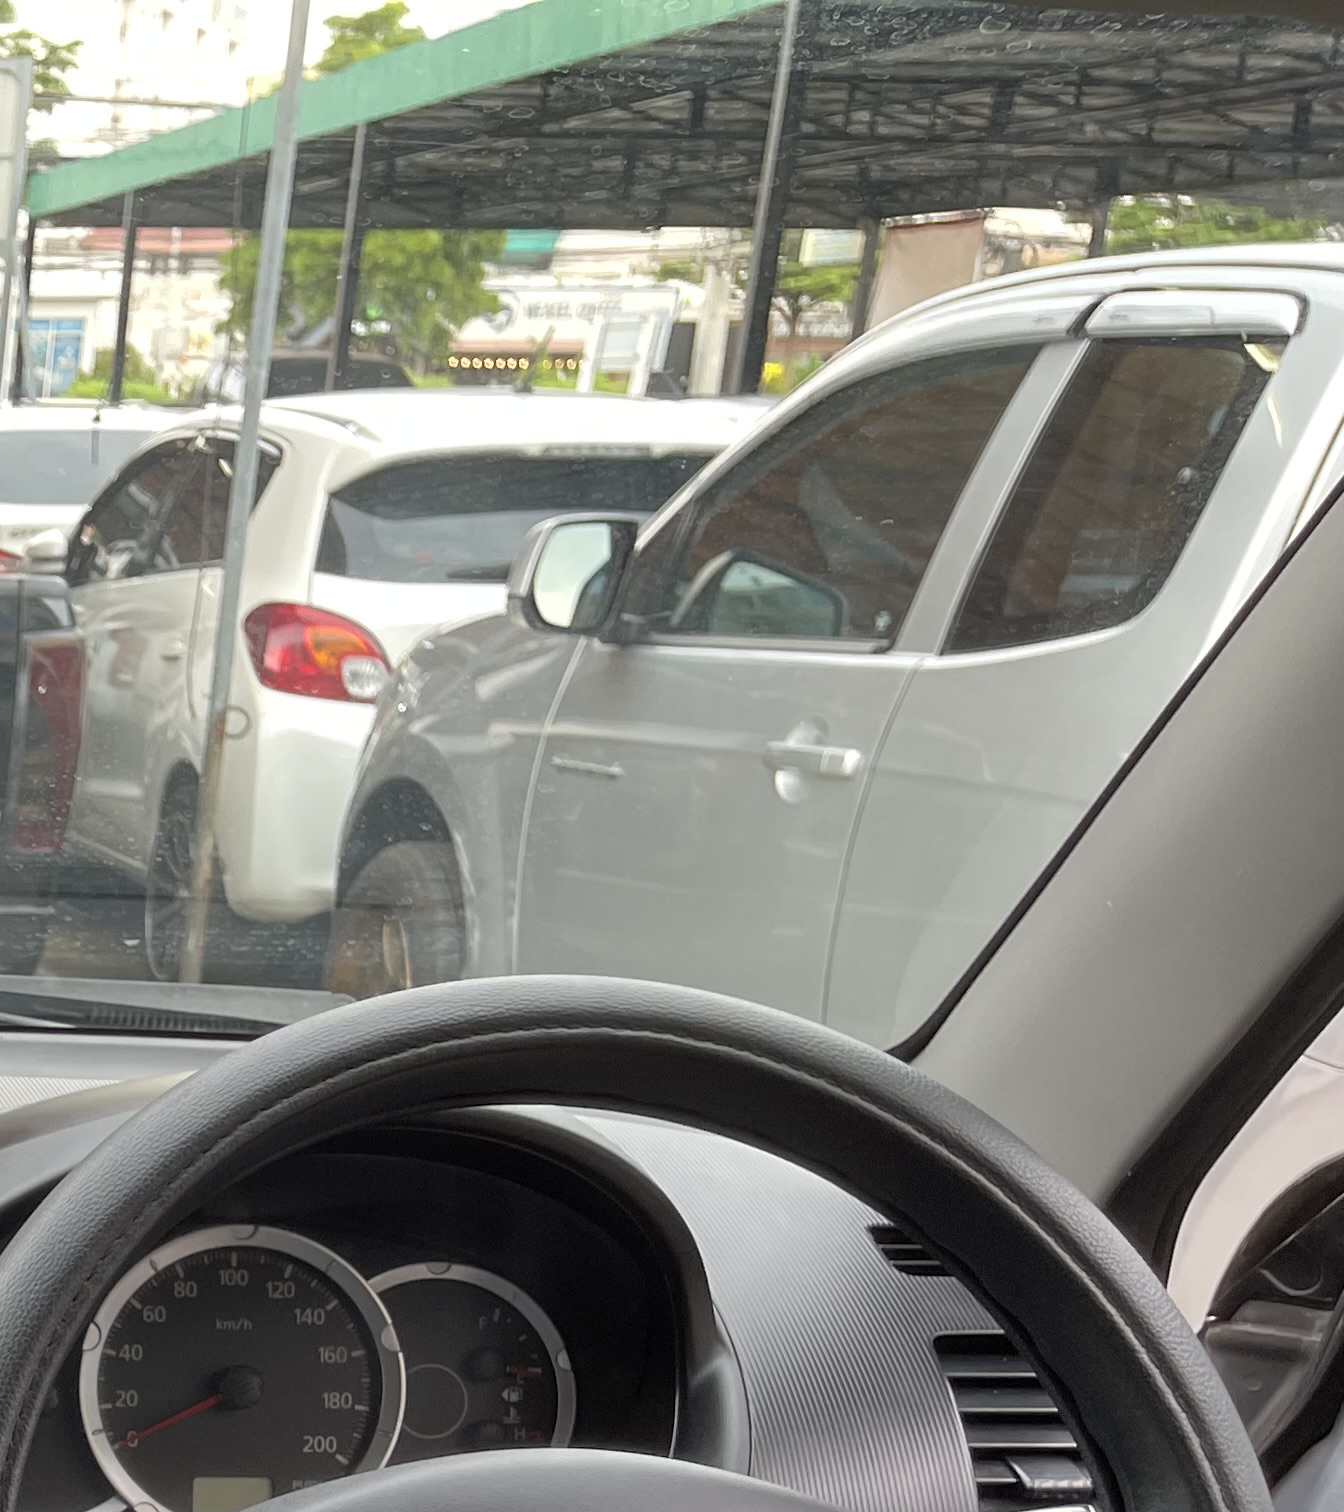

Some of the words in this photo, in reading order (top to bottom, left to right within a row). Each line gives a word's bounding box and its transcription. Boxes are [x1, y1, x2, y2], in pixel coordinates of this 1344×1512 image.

[219, 1269, 249, 1286] 100
[174, 1281, 197, 1298] 80
[265, 1281, 295, 1299] 120
[143, 1305, 166, 1323] 60
[294, 1308, 325, 1326] 140
[216, 1318, 253, 1331] km/h
[119, 1344, 143, 1361] 40
[318, 1346, 347, 1364] 160
[115, 1390, 138, 1407] 20
[322, 1392, 352, 1409] 180
[303, 1435, 337, 1453] 200
